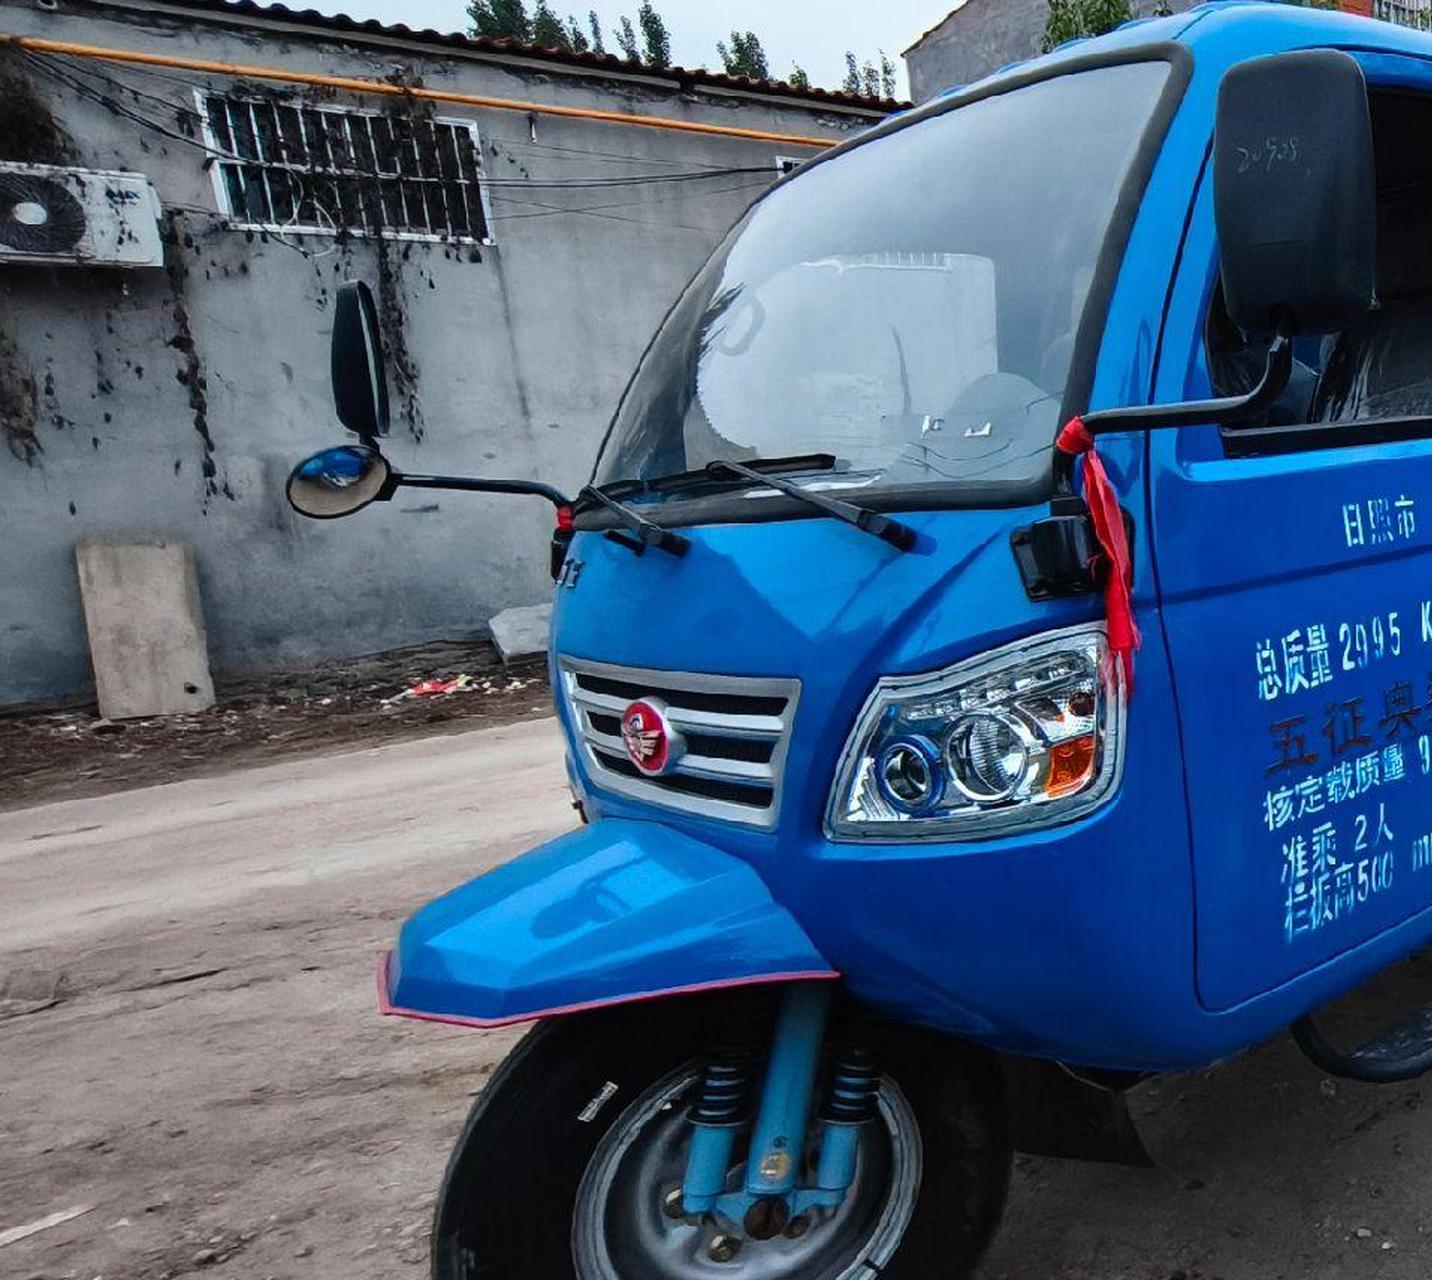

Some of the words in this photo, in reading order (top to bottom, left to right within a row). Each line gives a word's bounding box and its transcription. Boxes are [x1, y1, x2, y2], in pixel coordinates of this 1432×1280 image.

[1342, 494, 1414, 547] 日照市
[1256, 623, 1333, 700] 总质量
[1264, 743, 1405, 831] 核定载质量
